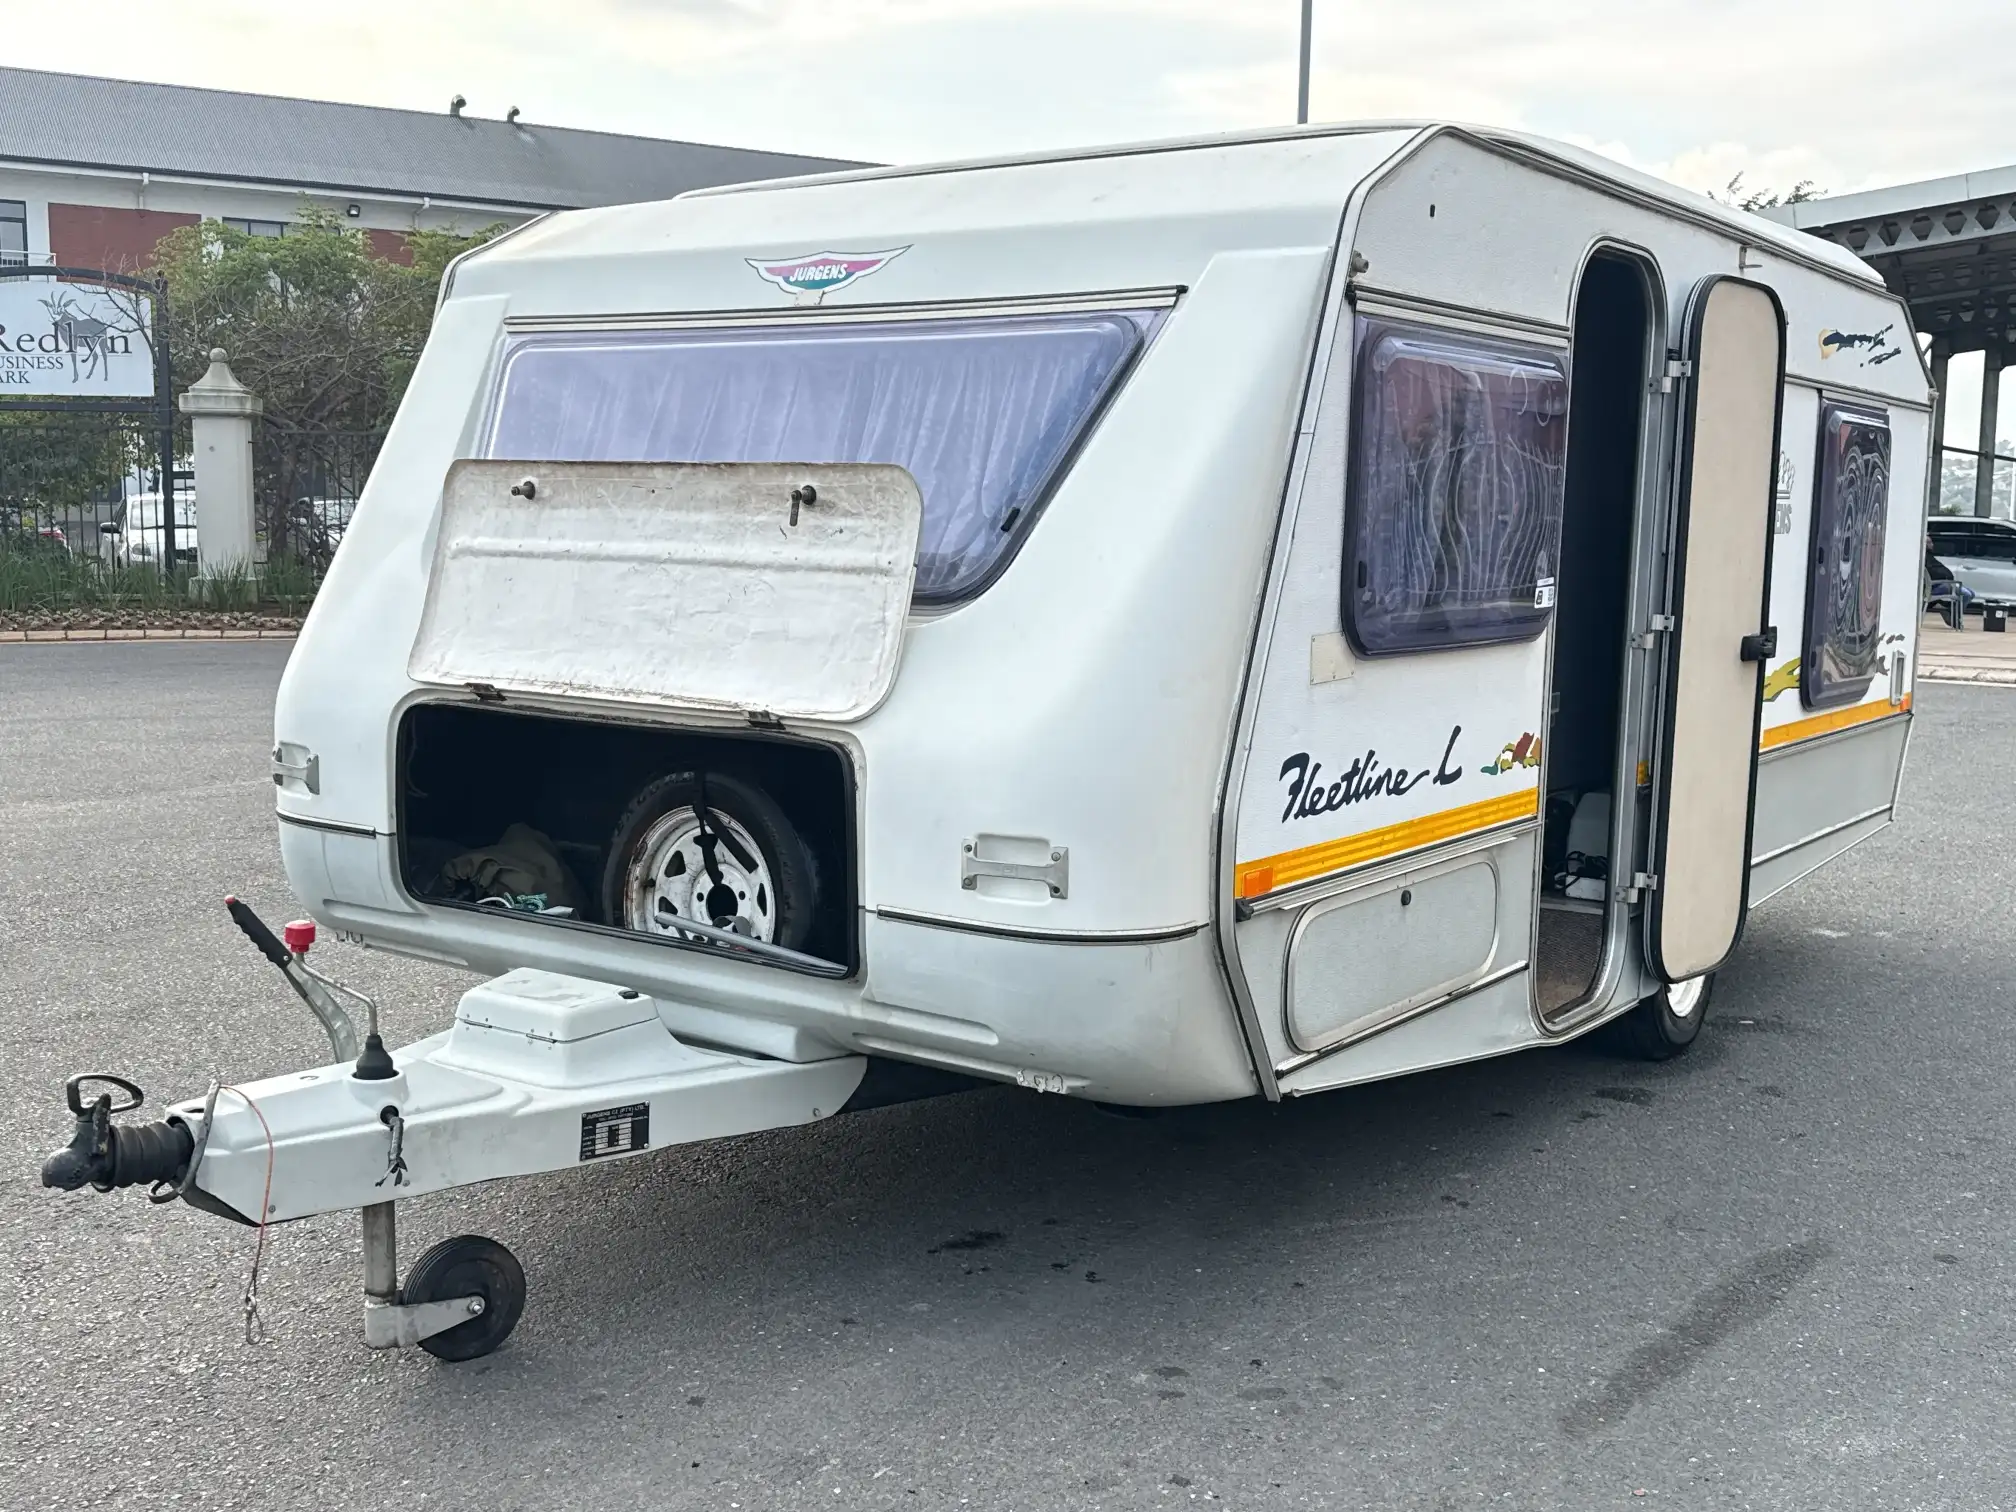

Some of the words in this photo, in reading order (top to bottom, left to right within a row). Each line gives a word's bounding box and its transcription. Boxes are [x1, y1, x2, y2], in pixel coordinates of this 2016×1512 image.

[789, 263, 849, 282] JURGENS
[1278, 749, 1430, 824] Fleetline
[1432, 724, 1463, 786] L
